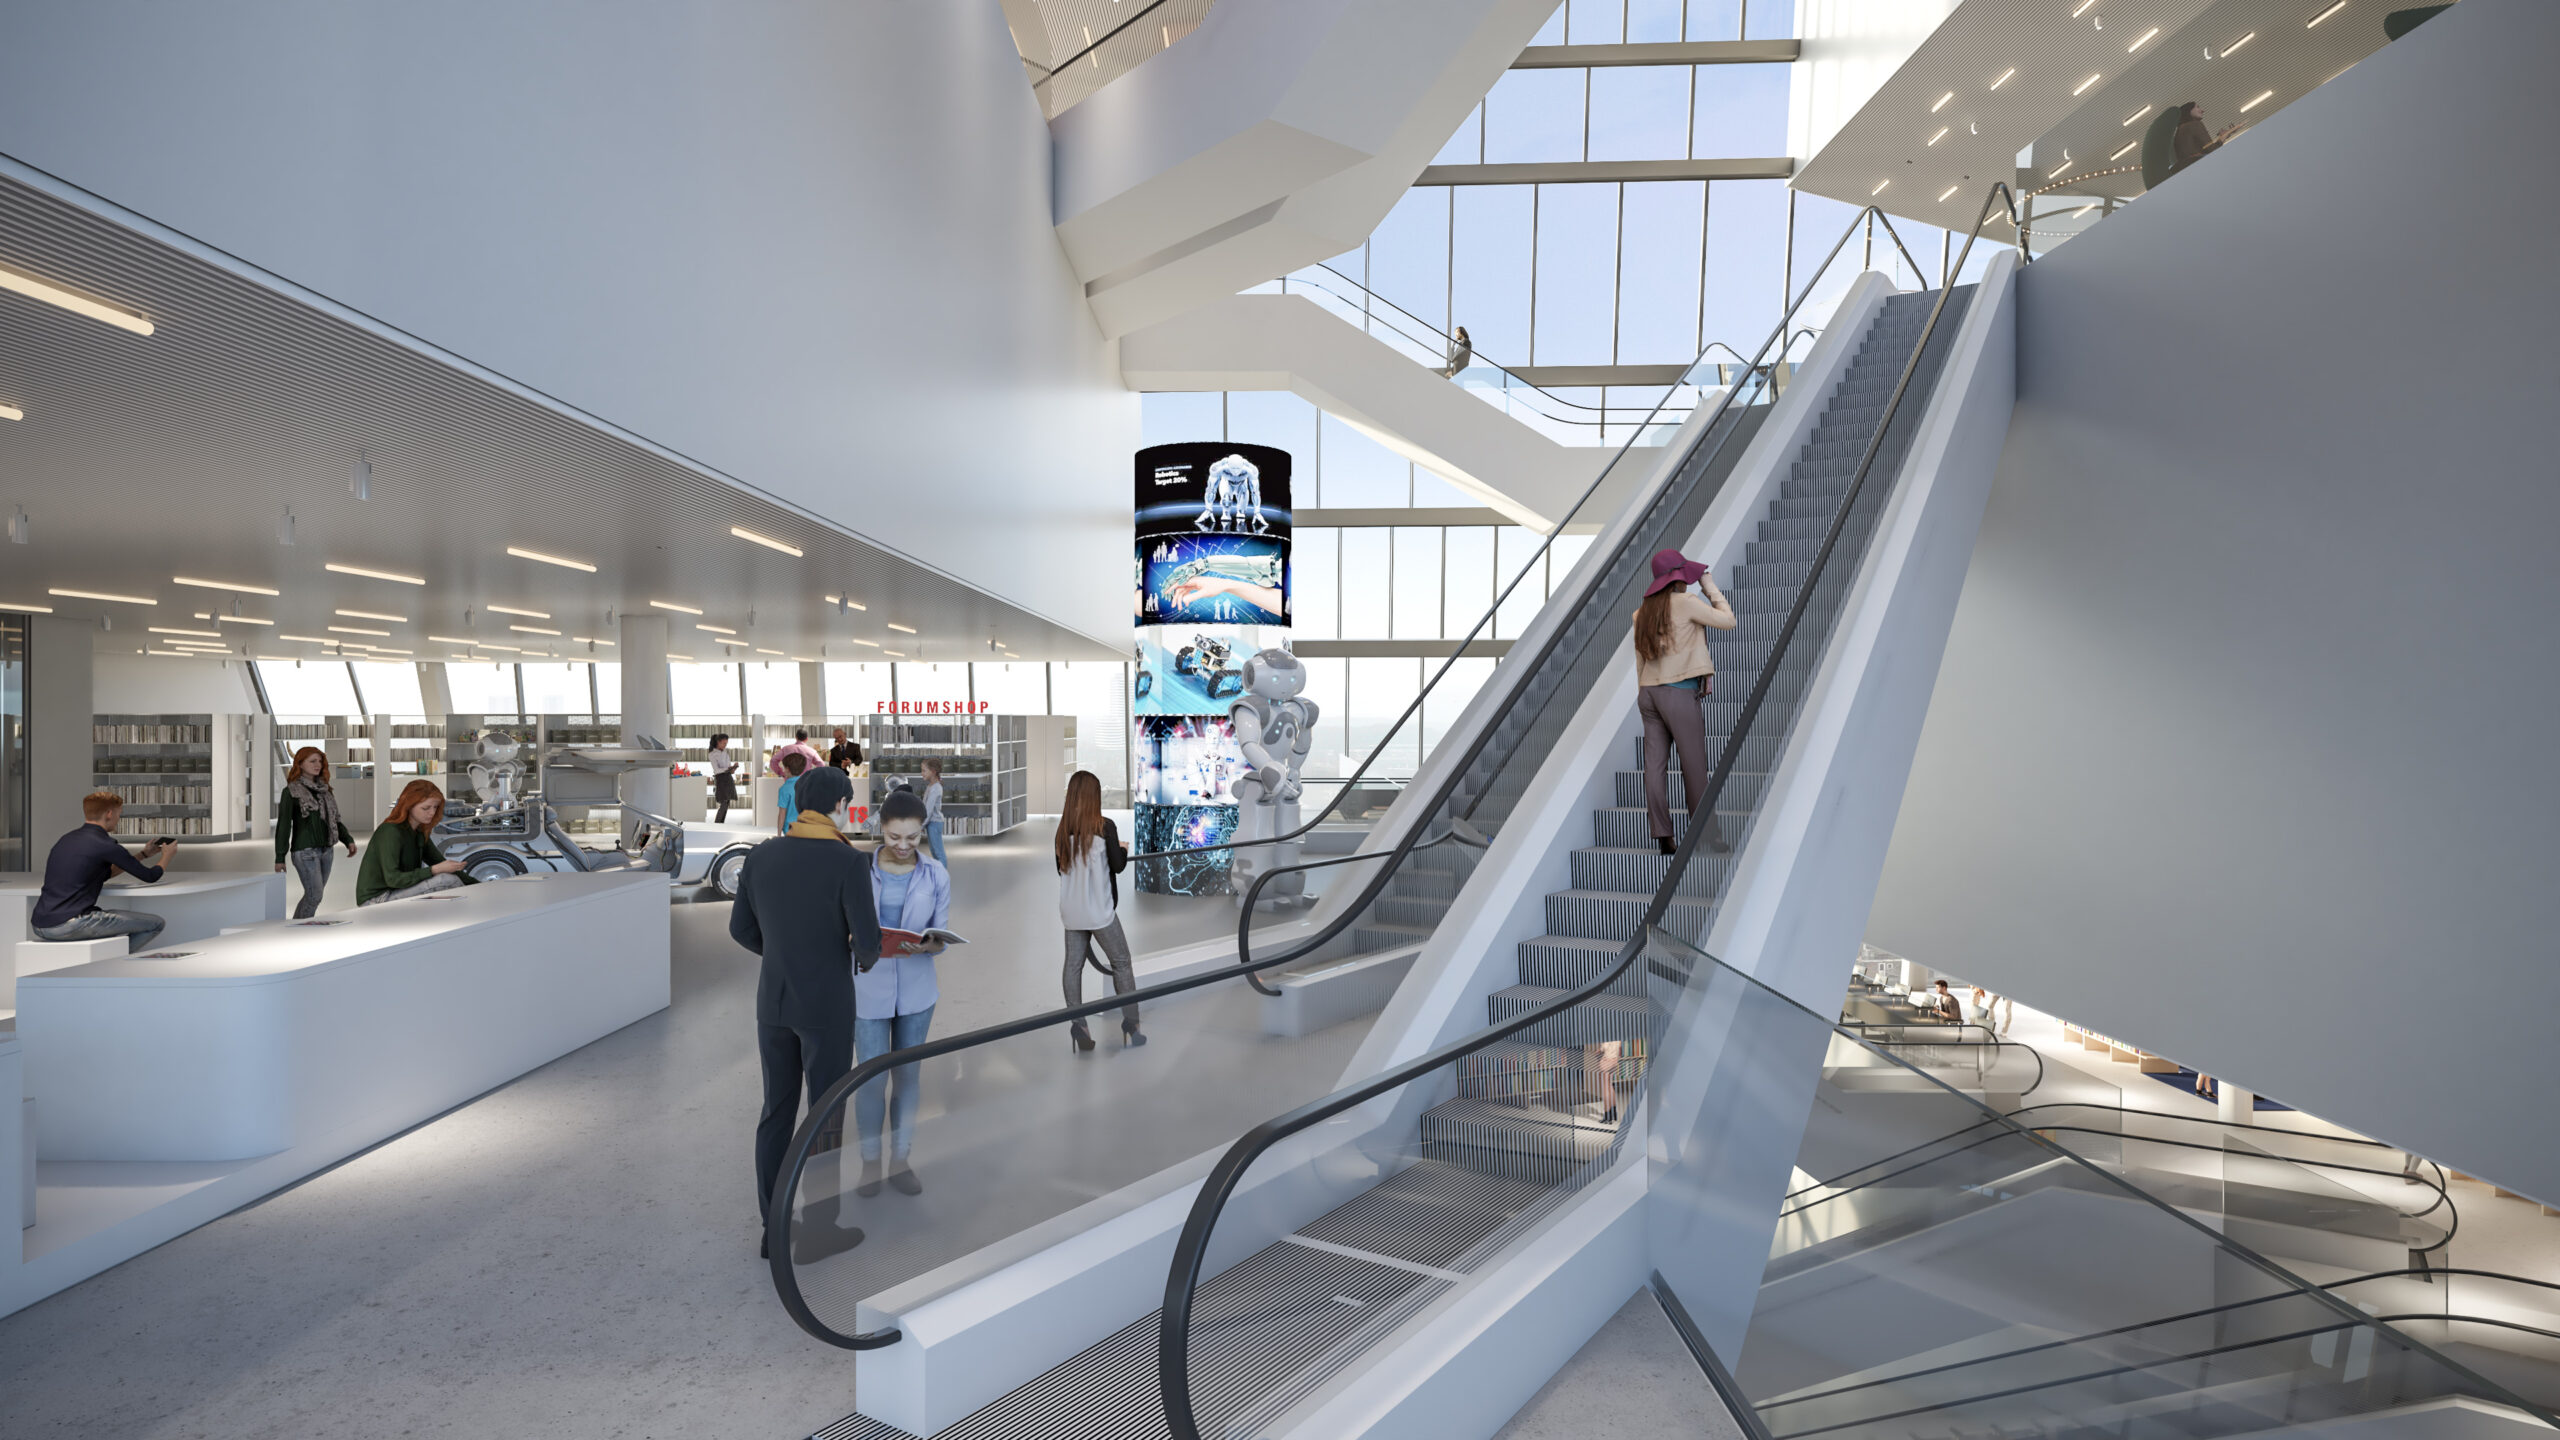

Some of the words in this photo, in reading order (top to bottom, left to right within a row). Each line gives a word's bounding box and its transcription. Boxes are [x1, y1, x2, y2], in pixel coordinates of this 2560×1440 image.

[1155, 470, 1179, 478] Robotics
[1155, 478, 1172, 486] Target
[877, 701, 989, 714] FORUMSHOP
